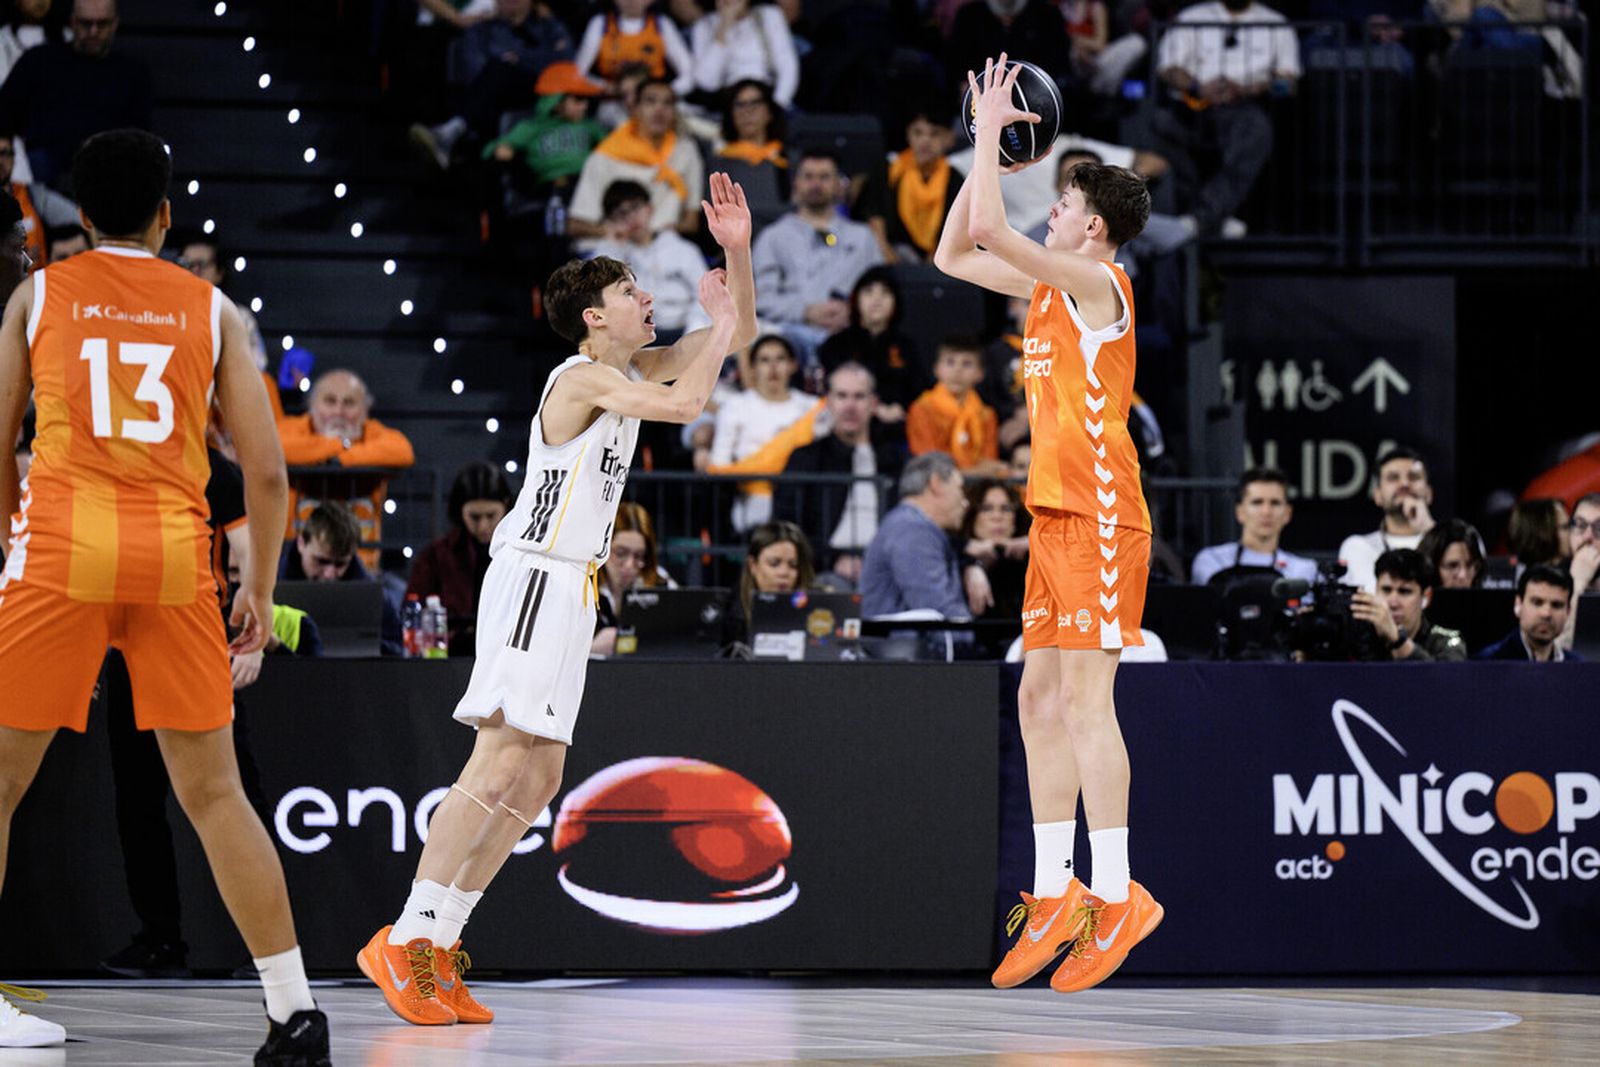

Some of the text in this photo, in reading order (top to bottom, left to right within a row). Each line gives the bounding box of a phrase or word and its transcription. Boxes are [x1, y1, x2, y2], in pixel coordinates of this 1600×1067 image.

[80, 338, 175, 443] 13
[1275, 855, 1334, 880] acb
[1471, 836, 1600, 881] ende
